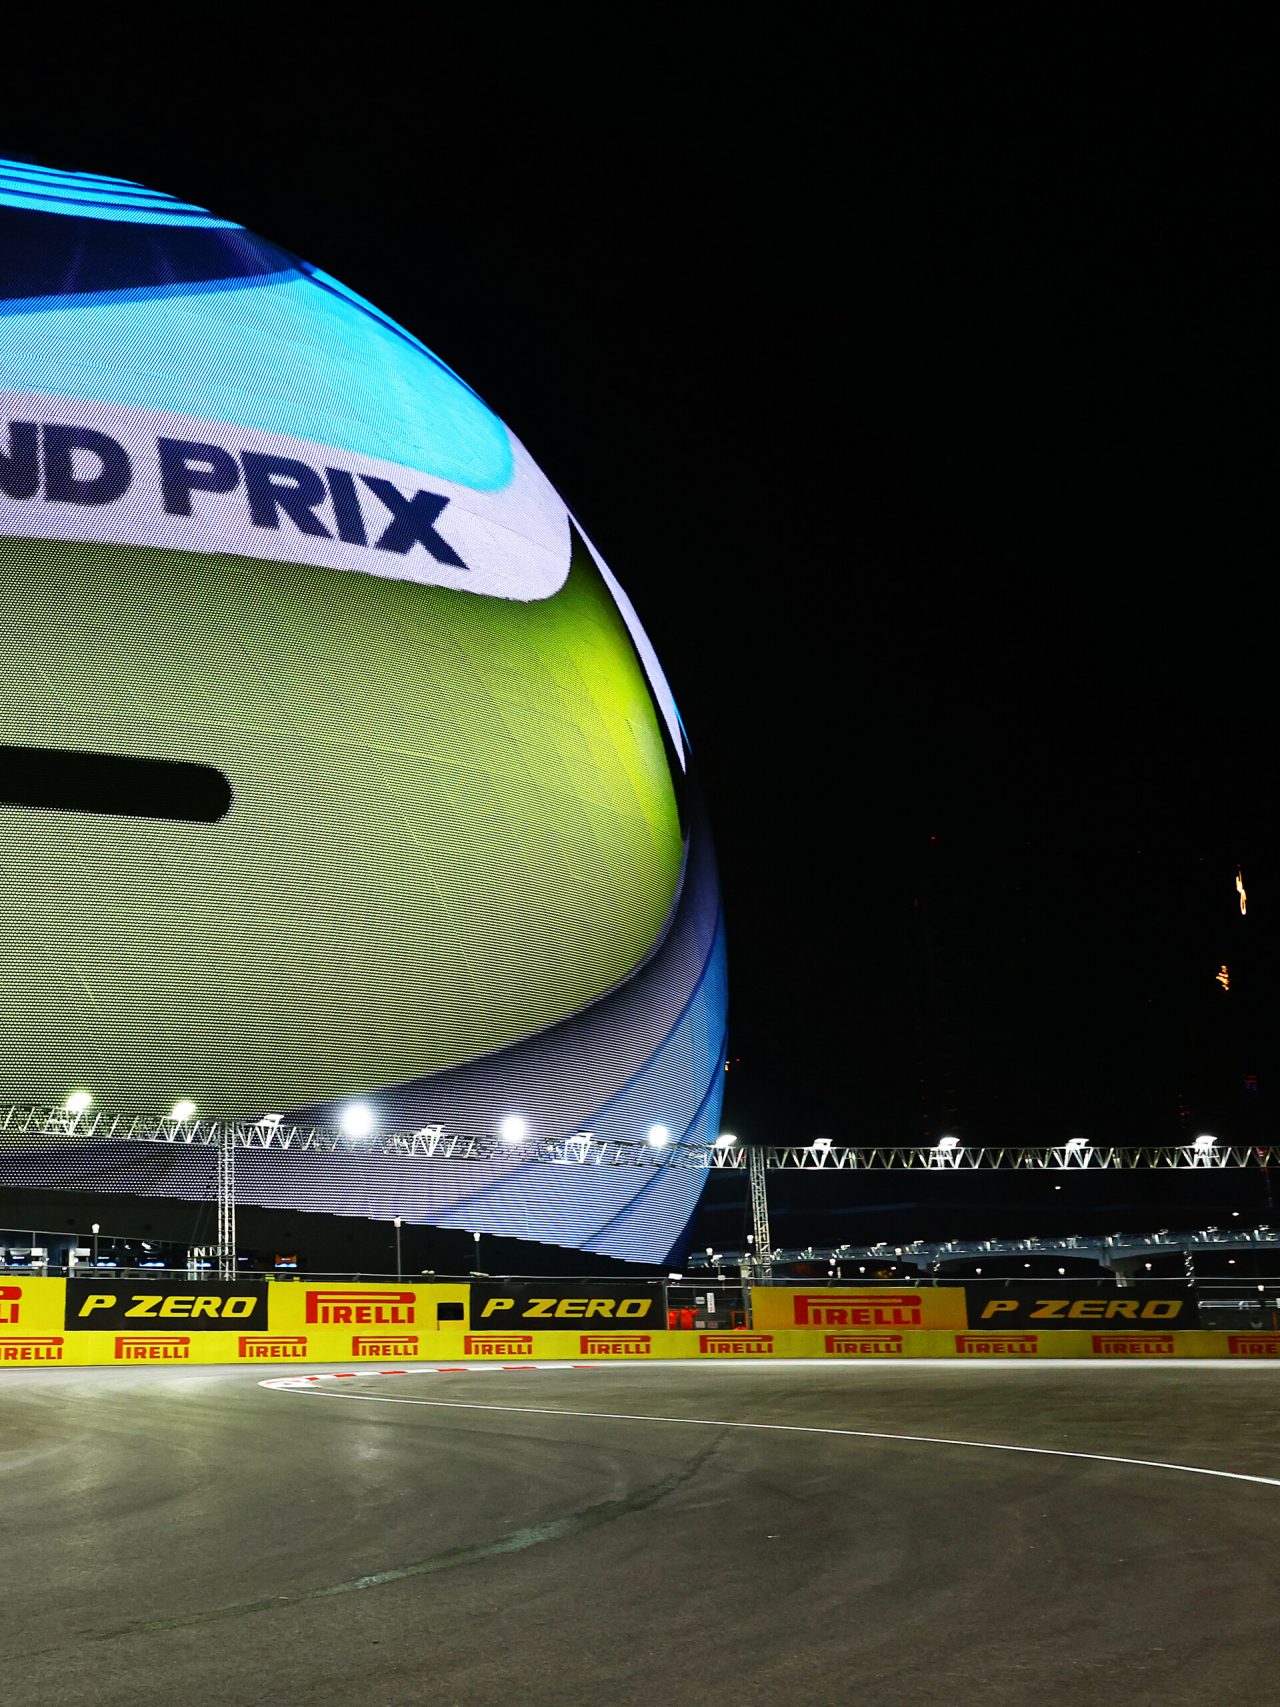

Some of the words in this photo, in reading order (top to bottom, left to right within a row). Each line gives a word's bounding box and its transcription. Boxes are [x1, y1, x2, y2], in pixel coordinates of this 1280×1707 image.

[157, 436, 470, 570] PRIX
[77, 1295, 117, 1318] P
[125, 1295, 258, 1318] ZERO
[306, 1291, 416, 1324] PIRELLI
[480, 1298, 515, 1318] P
[521, 1298, 653, 1318] ZERO
[794, 1295, 922, 1325] PIRELLI
[982, 1300, 1019, 1319] P
[1029, 1300, 1183, 1319] ZERO
[115, 1337, 190, 1359] PIRELLI
[238, 1336, 307, 1357] PIRELLI
[352, 1336, 419, 1356] PIRELLI
[464, 1336, 532, 1355] PIRELLI
[581, 1336, 651, 1354] PIRELLI
[700, 1335, 773, 1354] PIRELLI
[825, 1335, 902, 1354] PIRELLI
[956, 1335, 1038, 1354] PIRELLI
[1091, 1335, 1174, 1354] PIRELLI
[1227, 1335, 1280, 1354] PIRE
